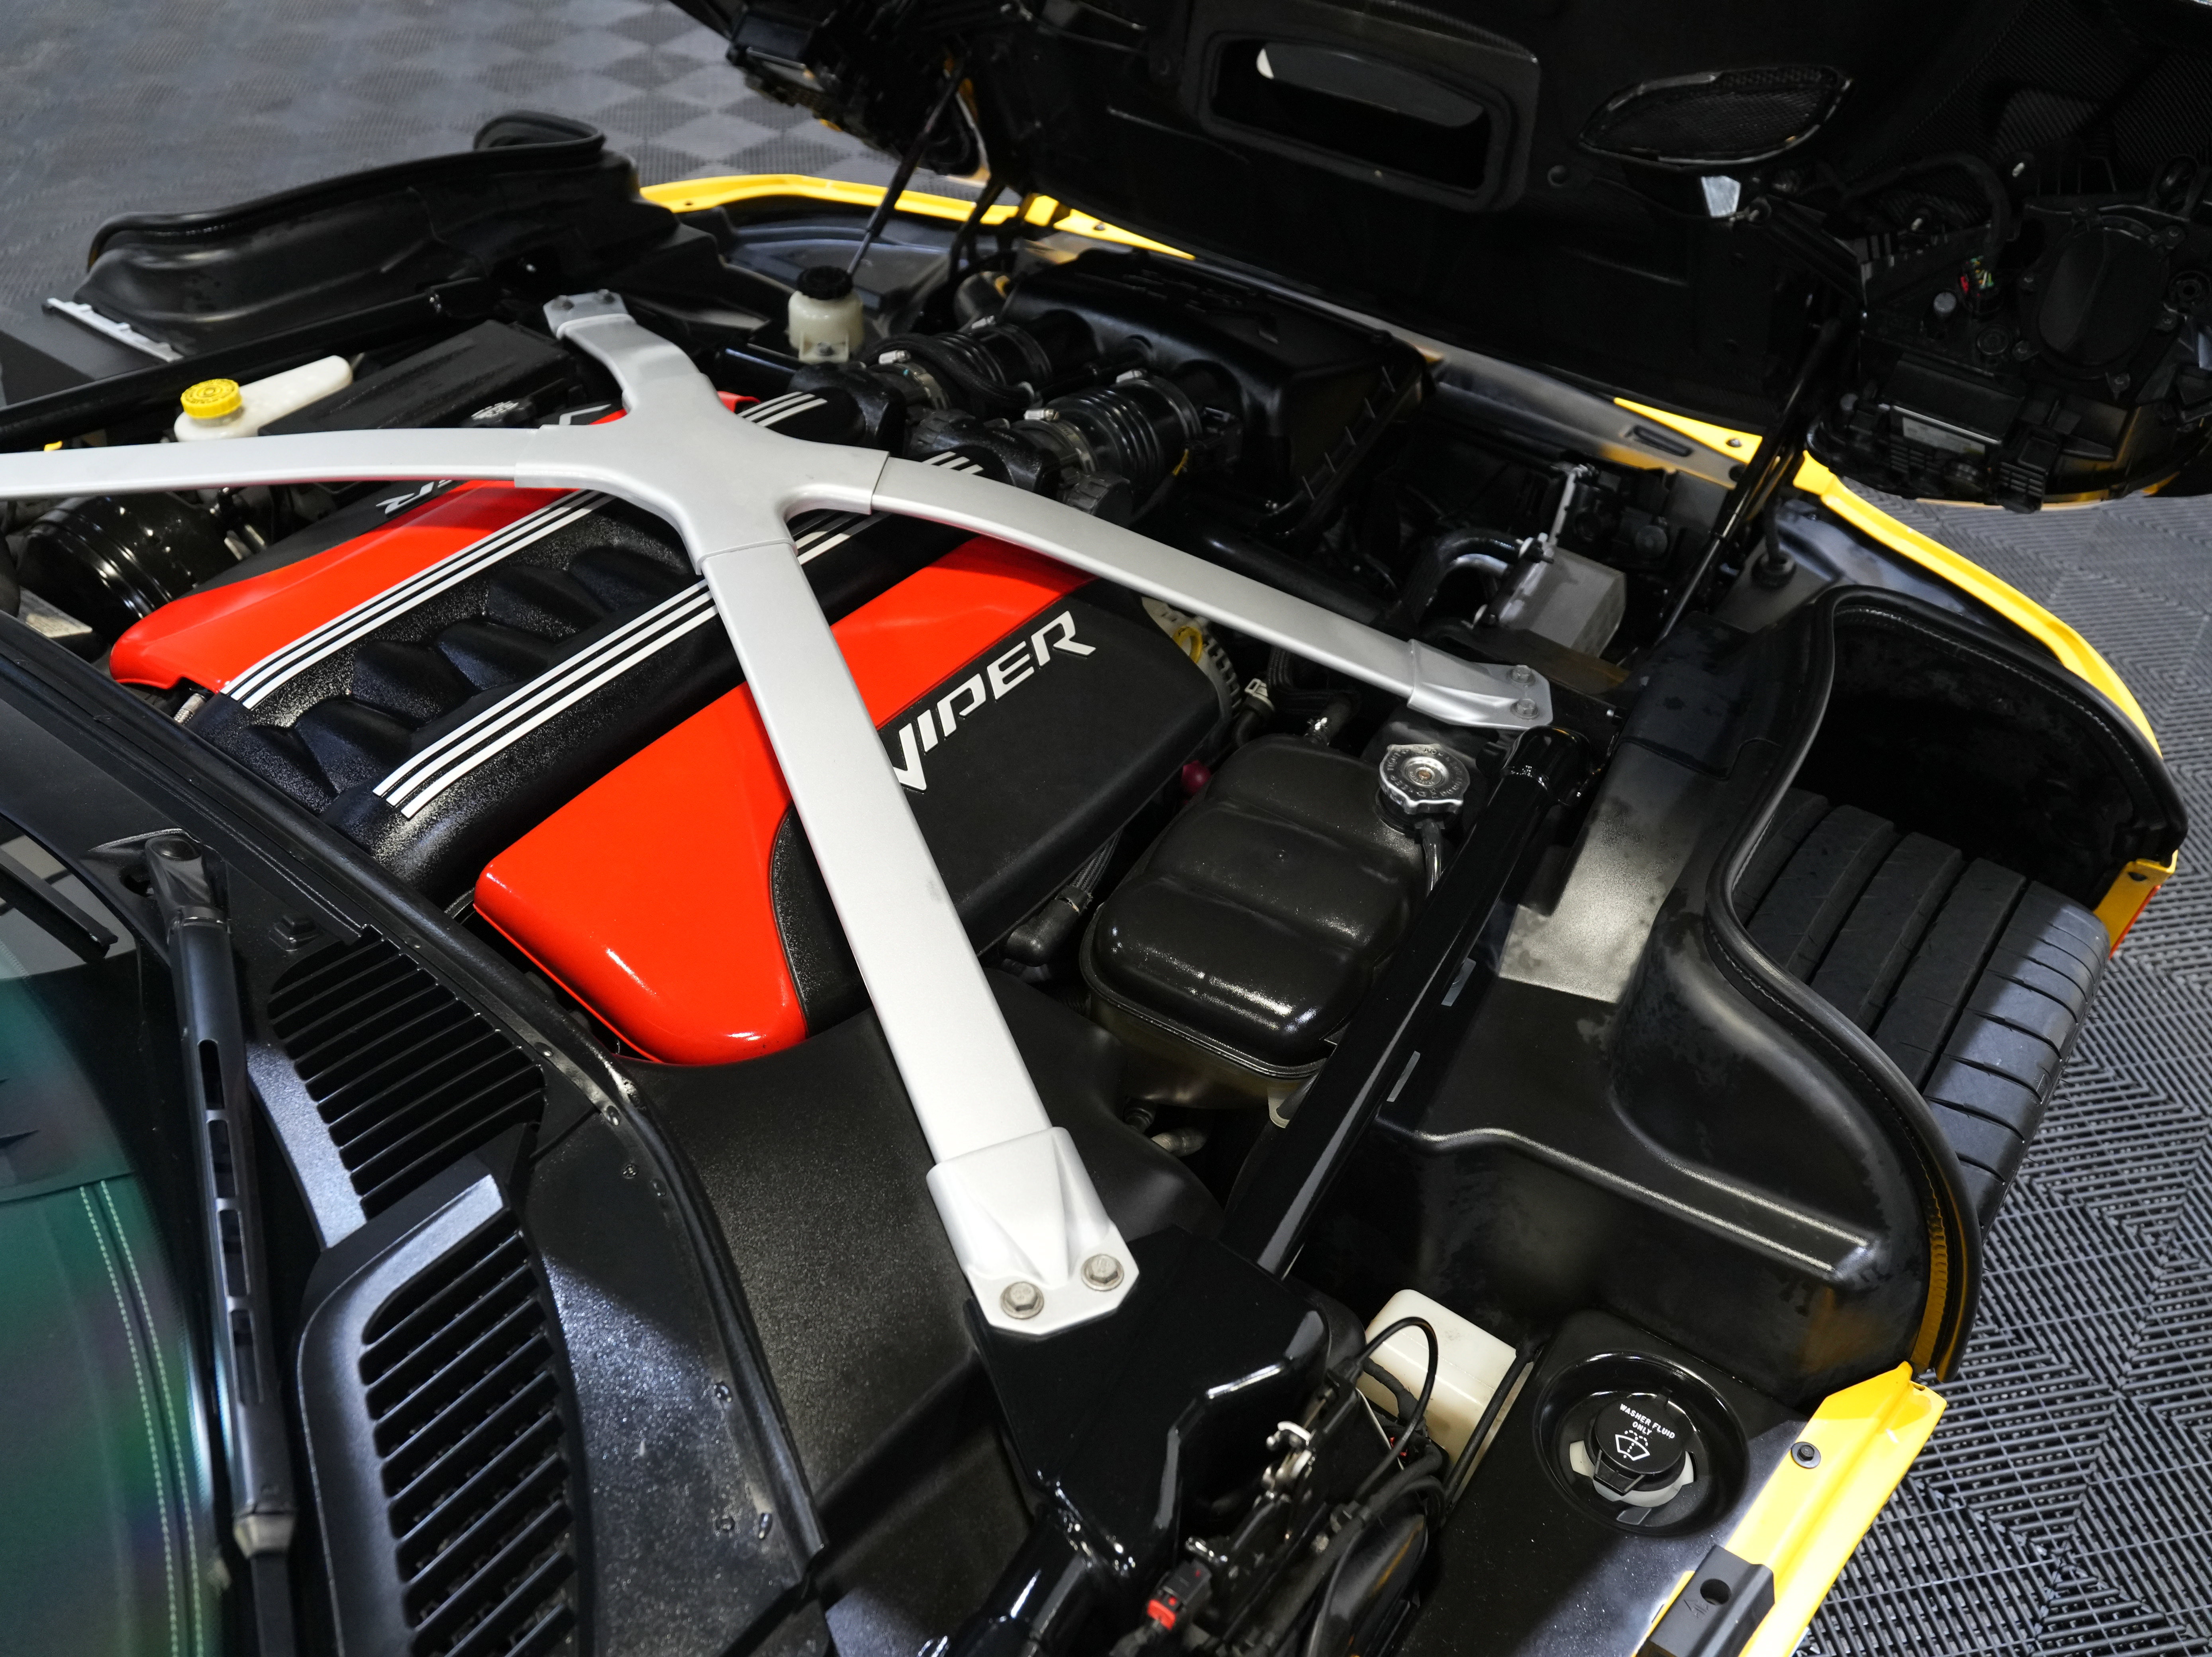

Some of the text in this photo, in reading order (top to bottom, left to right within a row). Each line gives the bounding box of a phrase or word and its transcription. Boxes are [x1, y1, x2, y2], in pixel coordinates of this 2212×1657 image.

[893, 611, 1096, 790] VIPER
[1620, 1403, 1675, 1439] WASHER FLUID
[1632, 1421, 1652, 1436] ONLY
